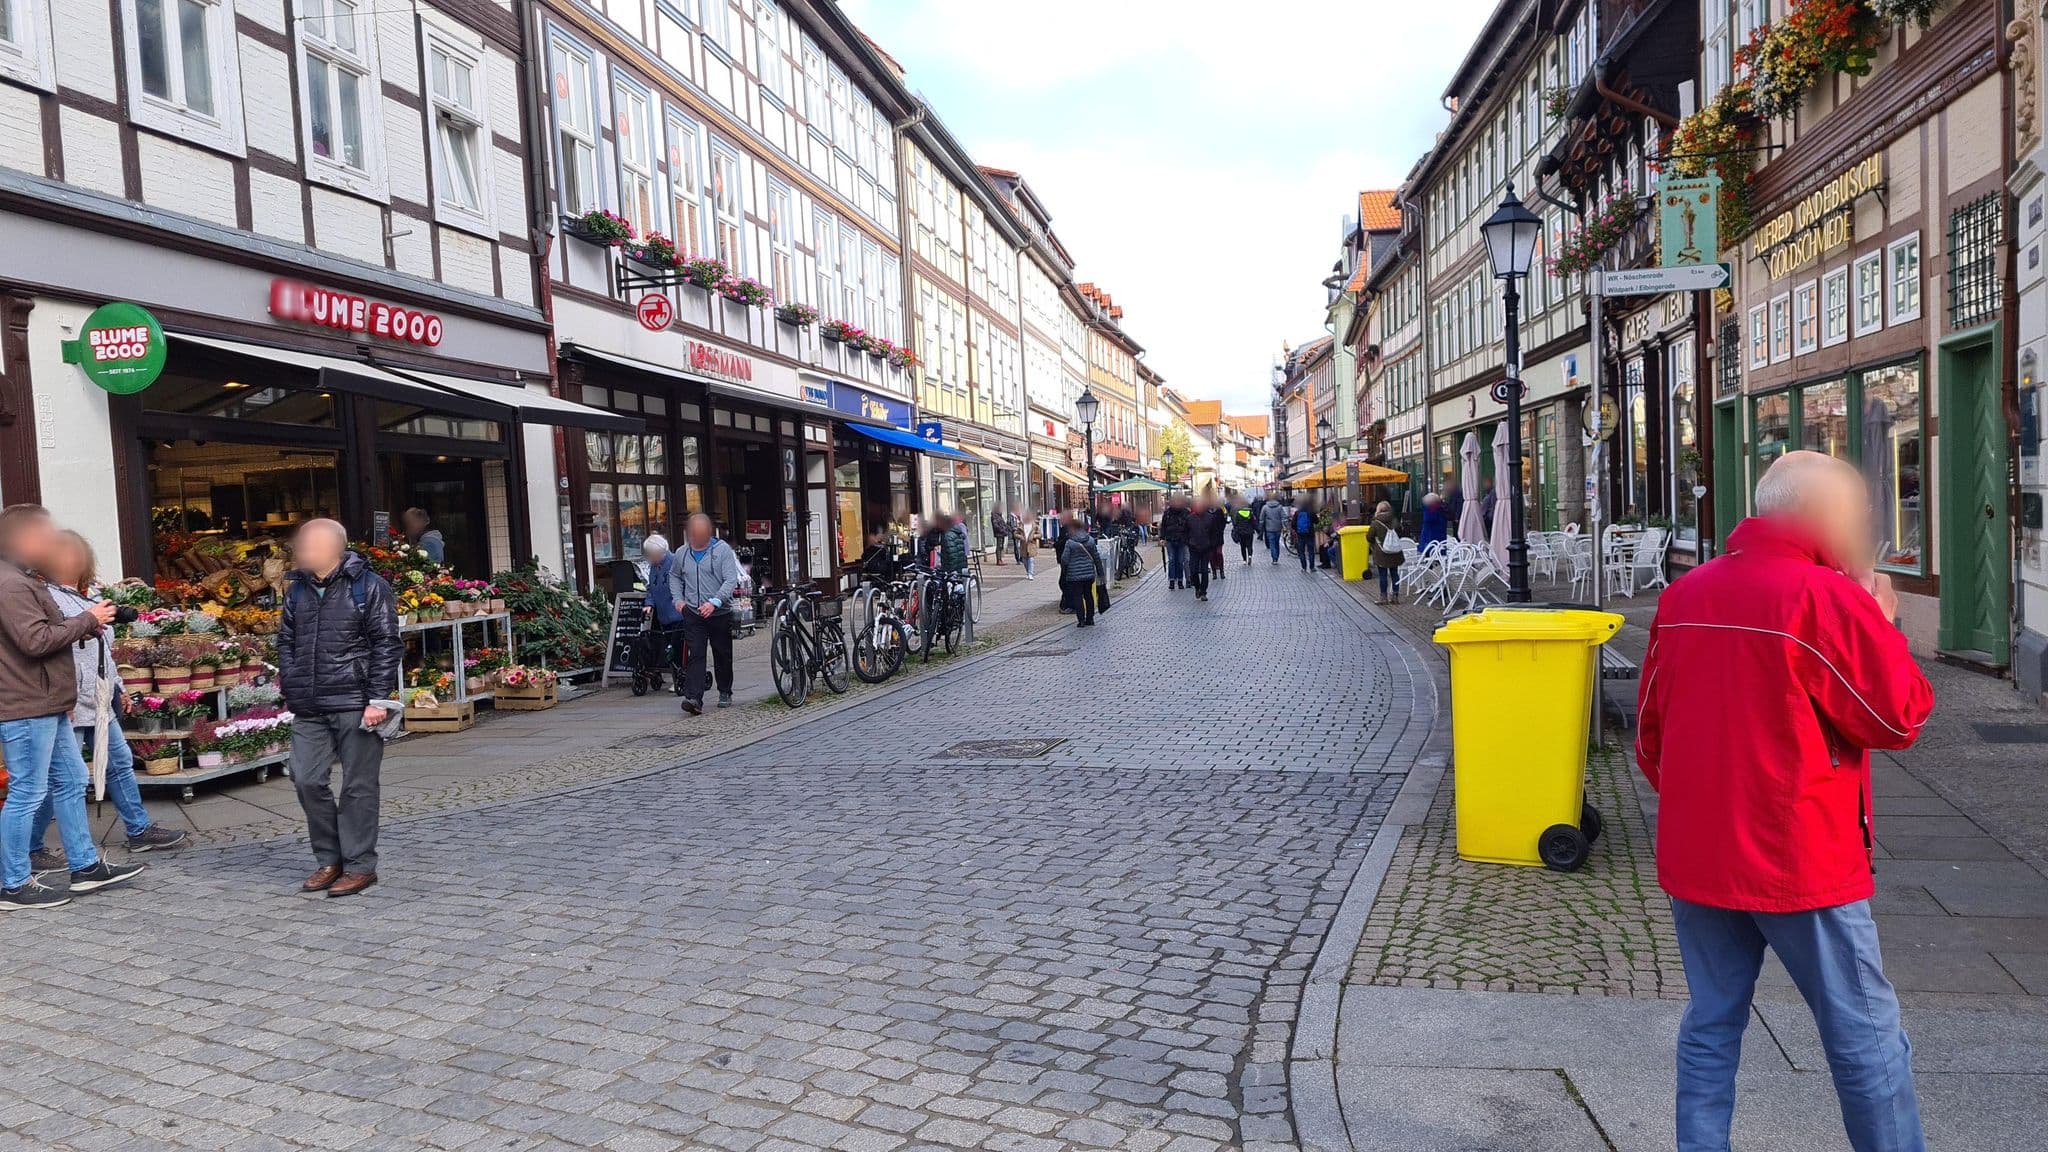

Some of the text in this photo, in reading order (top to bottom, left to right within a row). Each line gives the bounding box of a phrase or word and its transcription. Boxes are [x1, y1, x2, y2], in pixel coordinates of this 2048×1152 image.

[1753, 211, 1794, 257] ALFRED
[1770, 210, 1852, 280] GOLDSCHMIEDE
[1607, 285, 1634, 294] Wildpark
[1623, 272, 1664, 281] Nöschenrode
[278, 282, 442, 344] LUME 2000
[1660, 290, 1685, 328] WIEN
[89, 327, 149, 346] BLUME
[95, 343, 146, 360] 2000
[689, 341, 752, 381] ROSSMANN
